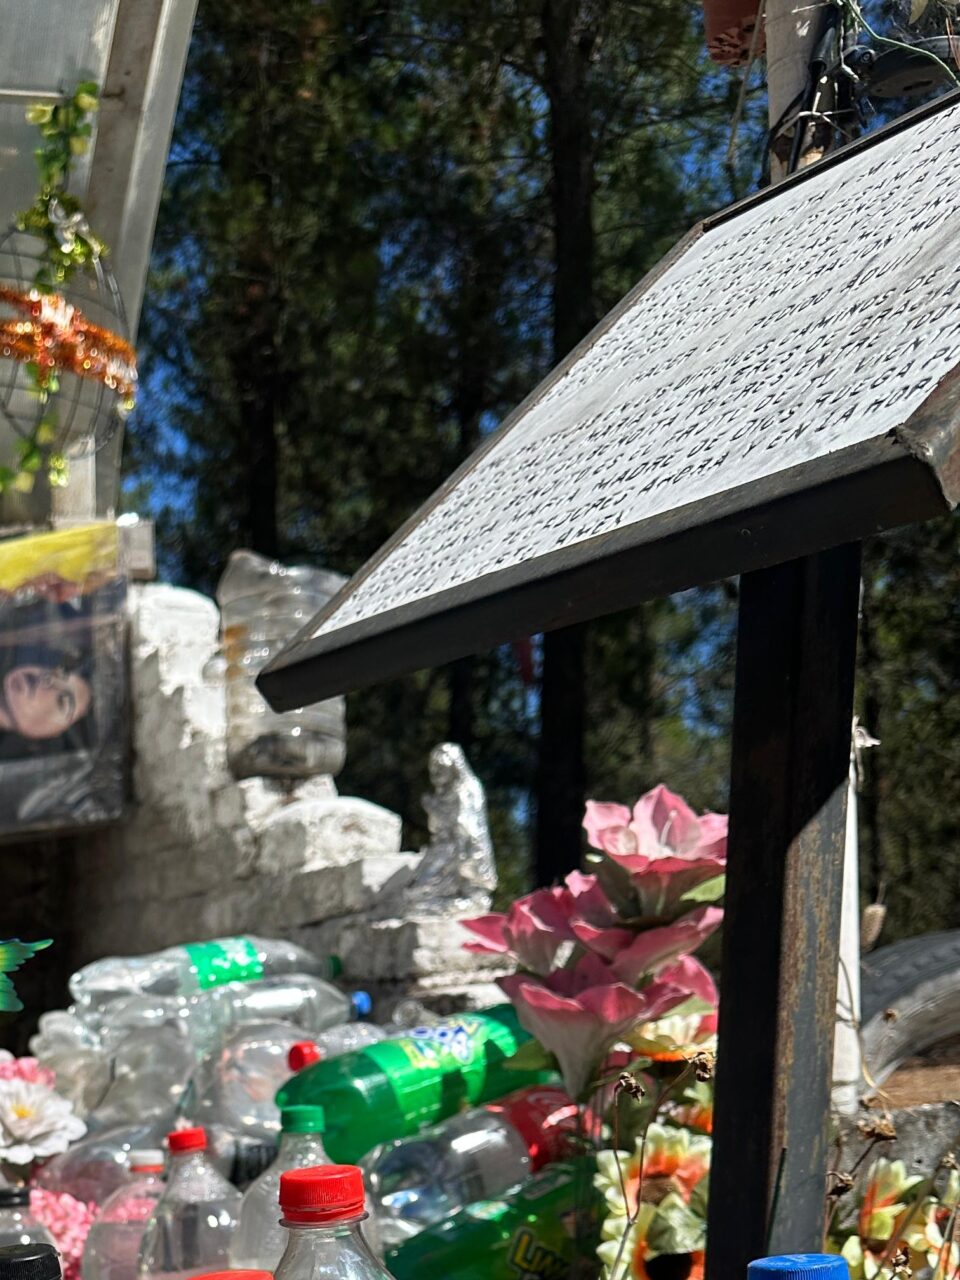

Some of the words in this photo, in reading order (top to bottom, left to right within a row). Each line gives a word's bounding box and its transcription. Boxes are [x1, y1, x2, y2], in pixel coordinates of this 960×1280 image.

[808, 185, 901, 237] DIGNES
[908, 171, 930, 188] A
[853, 219, 893, 245] ME
[745, 287, 833, 335] PEDIDO
[779, 287, 897, 346] CAMINOS
[903, 263, 946, 295] DE
[651, 375, 727, 417] LLENA
[805, 327, 844, 354] DE
[685, 396, 720, 420] TU
[720, 365, 794, 406] ERES
[794, 326, 891, 377] ENTRE
[754, 384, 796, 412] DE
[800, 366, 843, 394] TU
[592, 448, 684, 491] MADRE
[687, 429, 729, 458] DE
[729, 402, 803, 442] DIOS
[806, 359, 916, 414] RUEGA
[766, 418, 815, 450] EN
[814, 402, 859, 432] LA
[556, 507, 634, 544] AMEN
